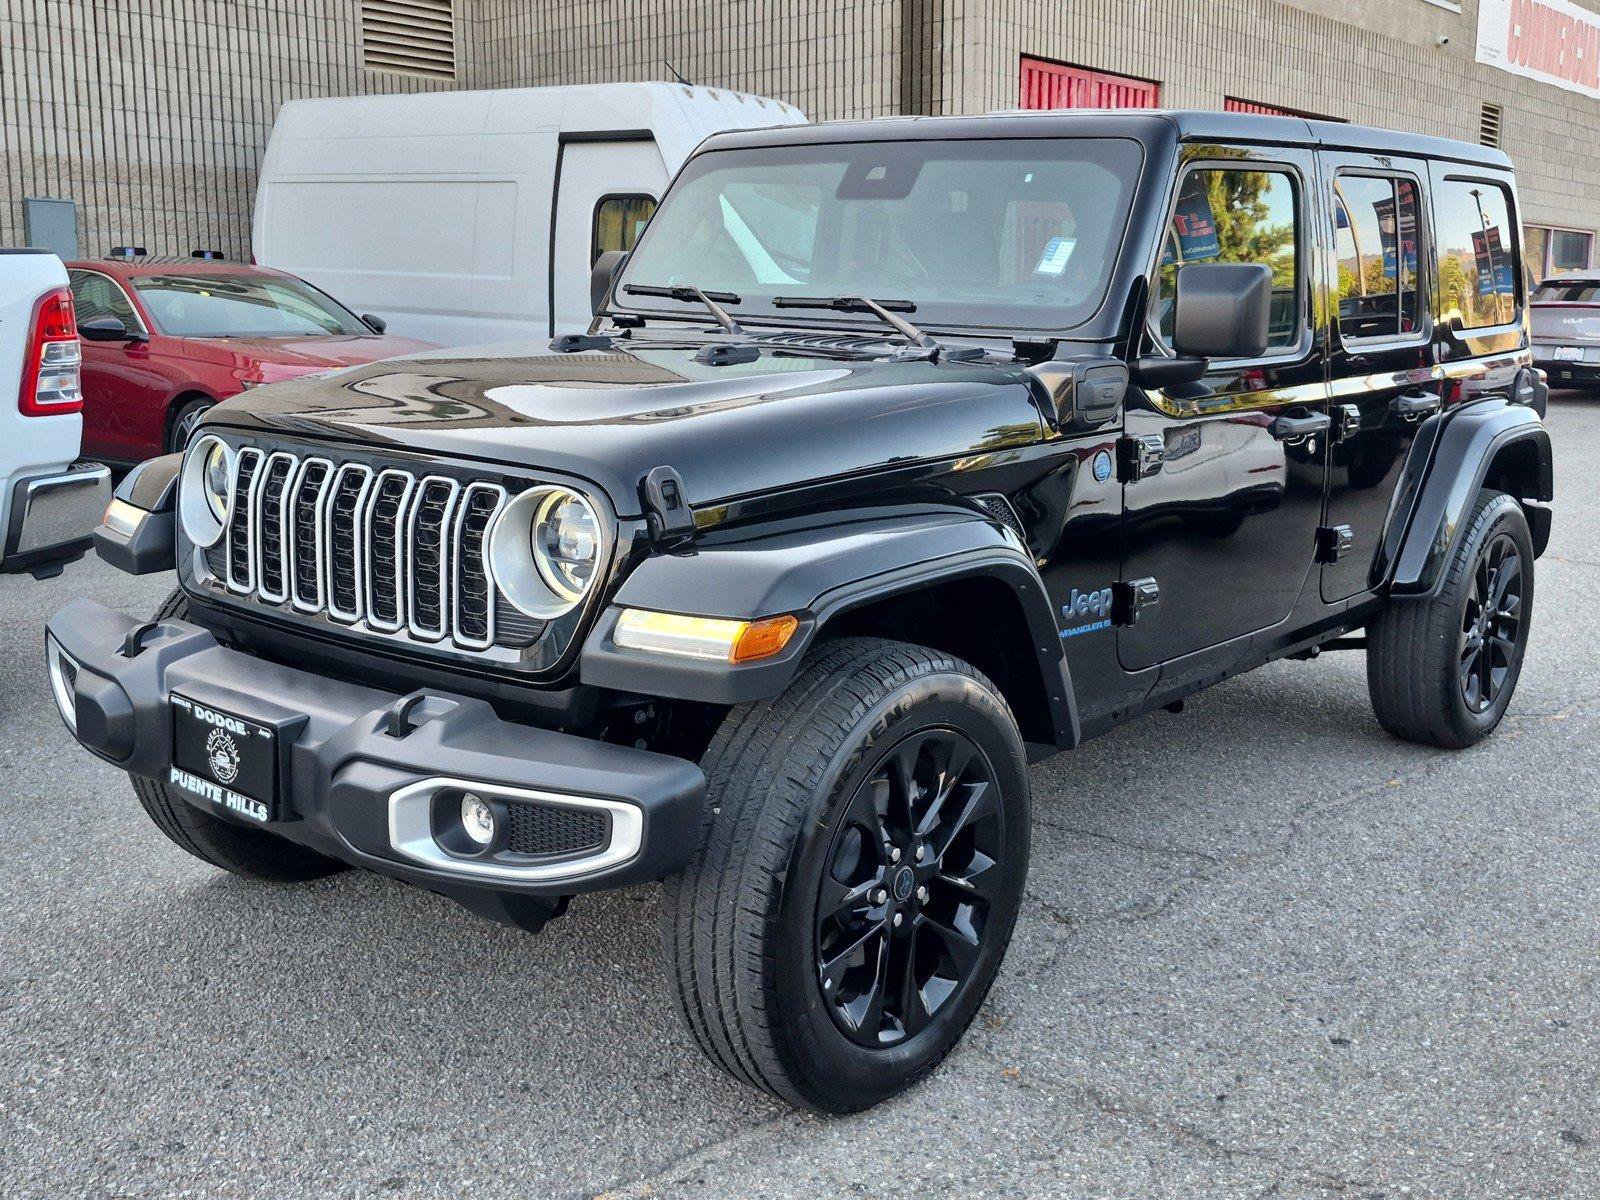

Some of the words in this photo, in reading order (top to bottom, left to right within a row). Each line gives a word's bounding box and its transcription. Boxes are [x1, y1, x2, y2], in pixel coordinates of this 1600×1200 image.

[1062, 588, 1112, 618] Jeep
[1060, 622, 1103, 638] WRANGLER
[194, 705, 247, 736] DODGE
[170, 767, 223, 803] PUENTE
[226, 791, 268, 822] HILLS
